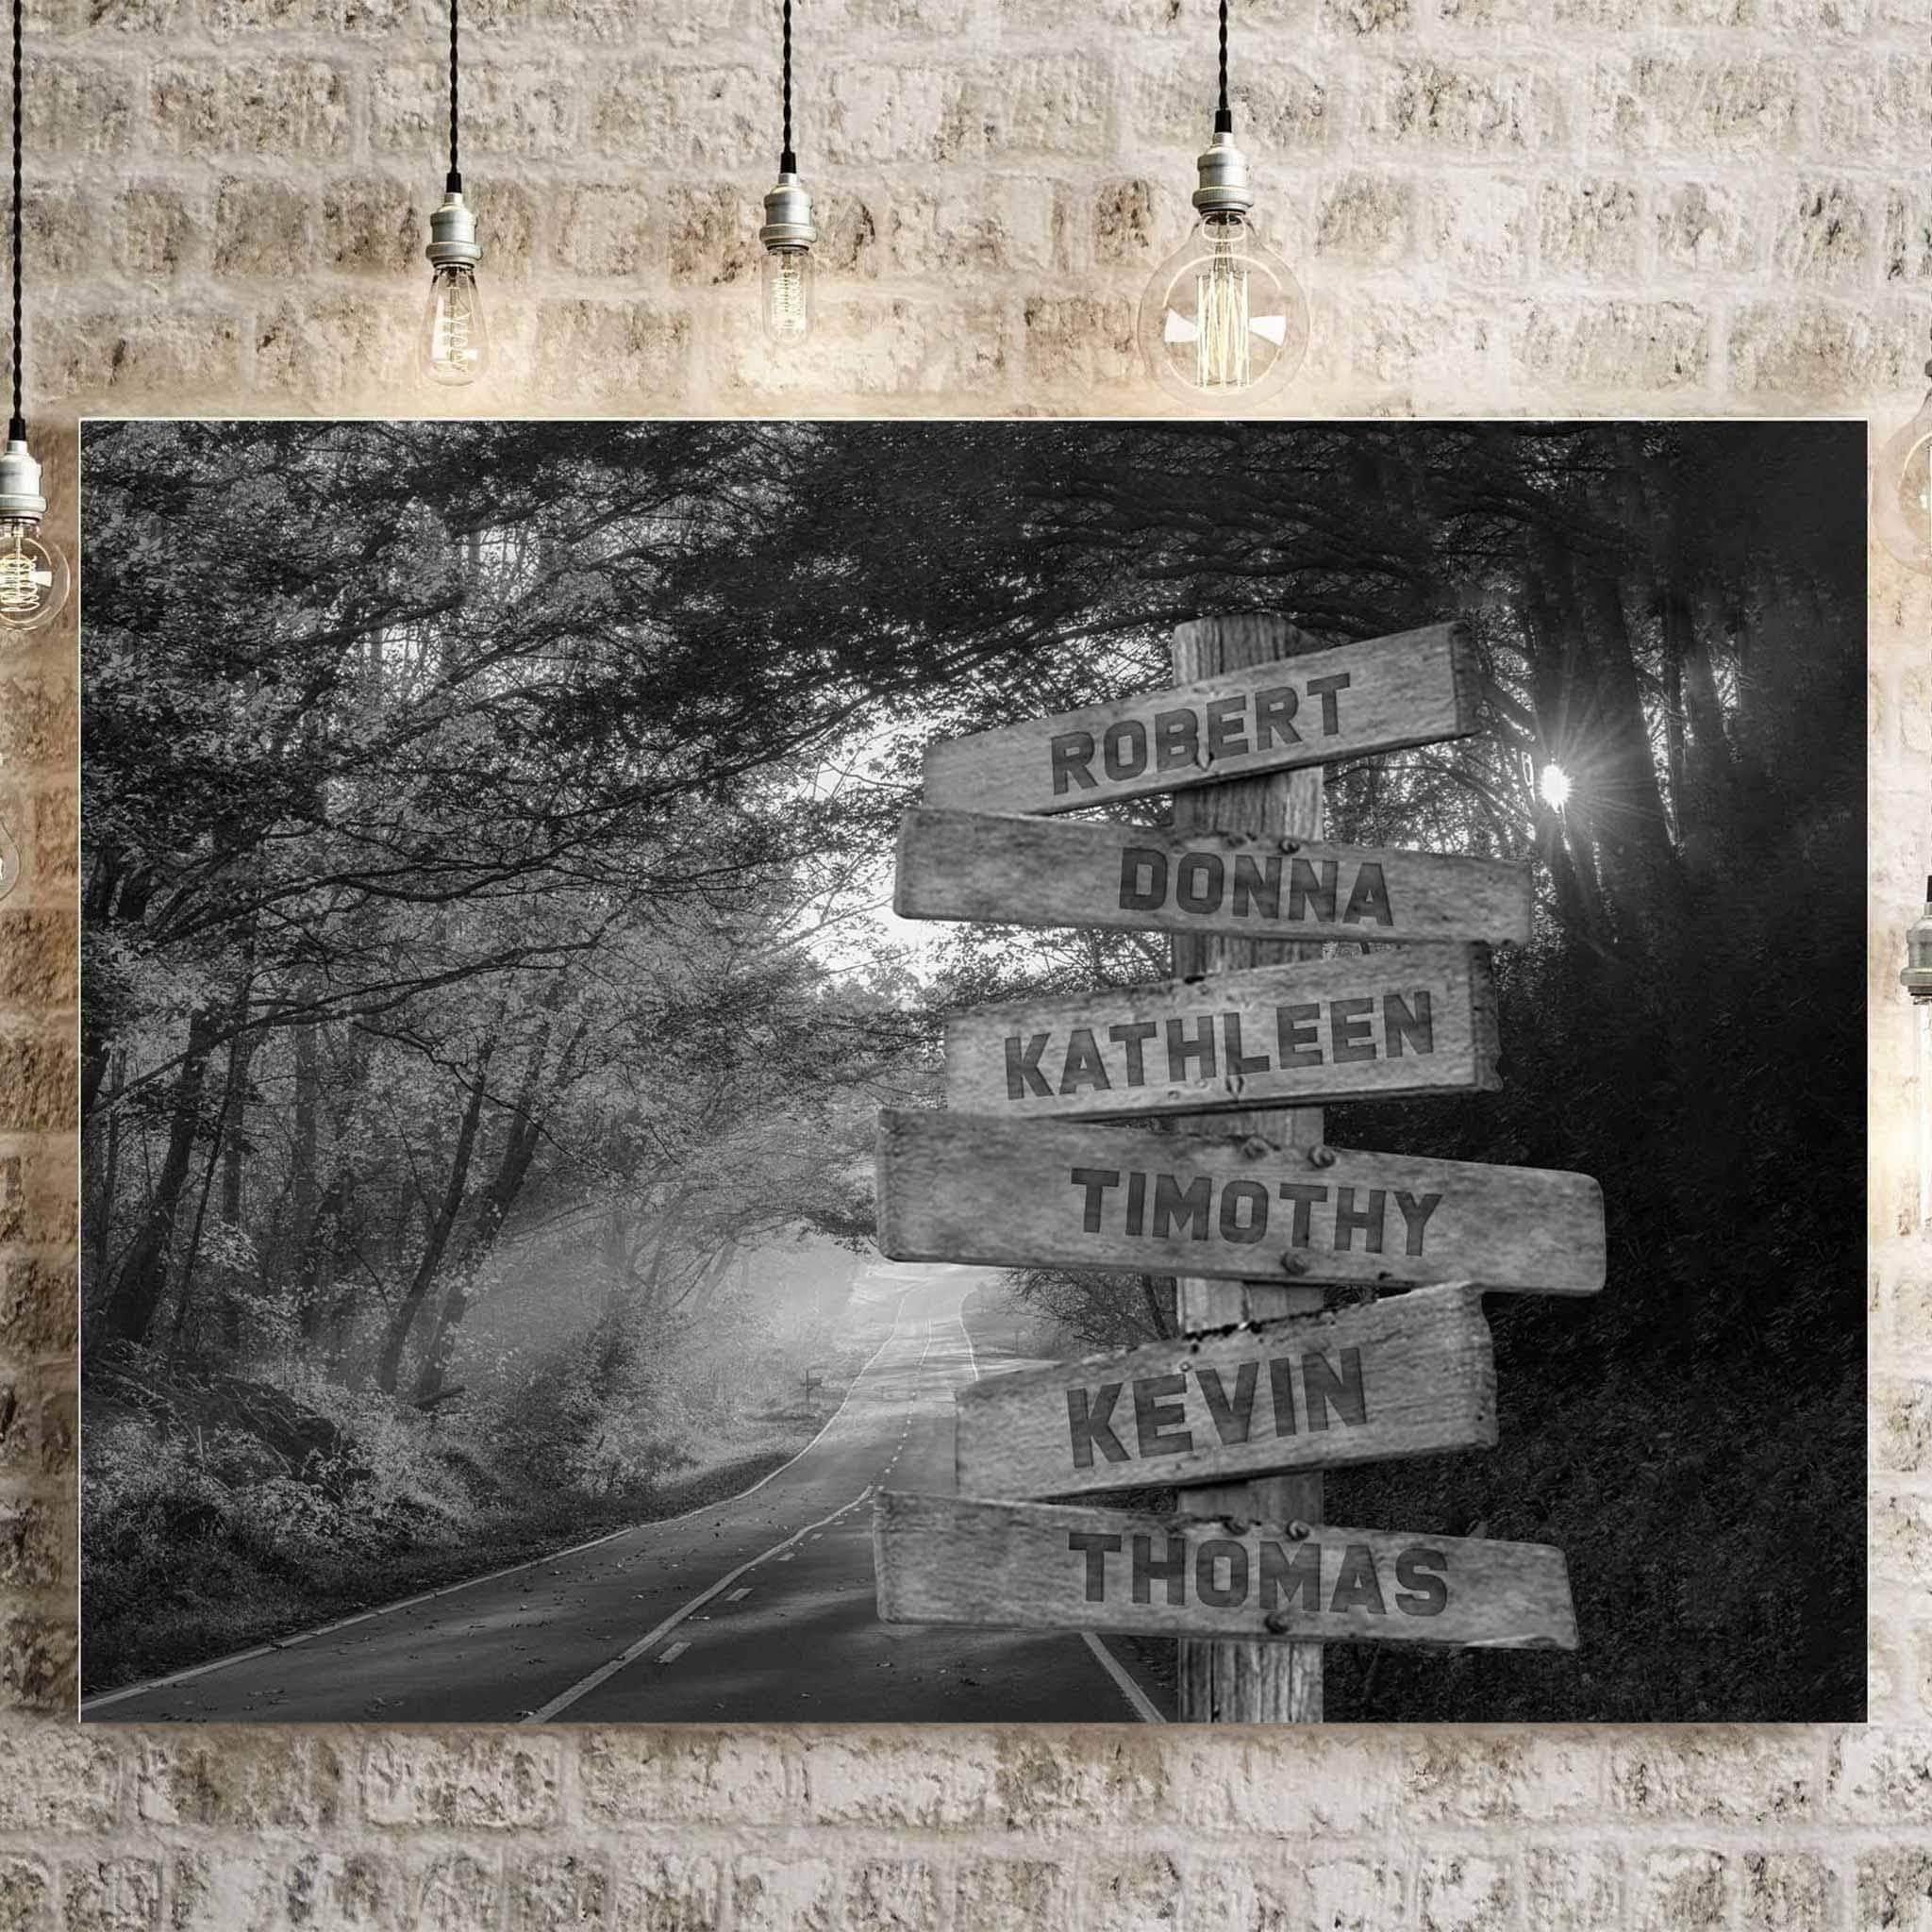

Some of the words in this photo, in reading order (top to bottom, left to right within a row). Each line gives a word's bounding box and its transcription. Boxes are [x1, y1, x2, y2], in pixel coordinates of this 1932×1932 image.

[1052, 673, 1351, 794] ROBERT
[1120, 846, 1394, 927] DONNA
[1005, 990, 1434, 1100] KATHLEEN
[1070, 1168, 1442, 1257] TIMOTHY
[1068, 1347, 1367, 1469] KEVIN
[1069, 1534, 1449, 1616] THOMAS
